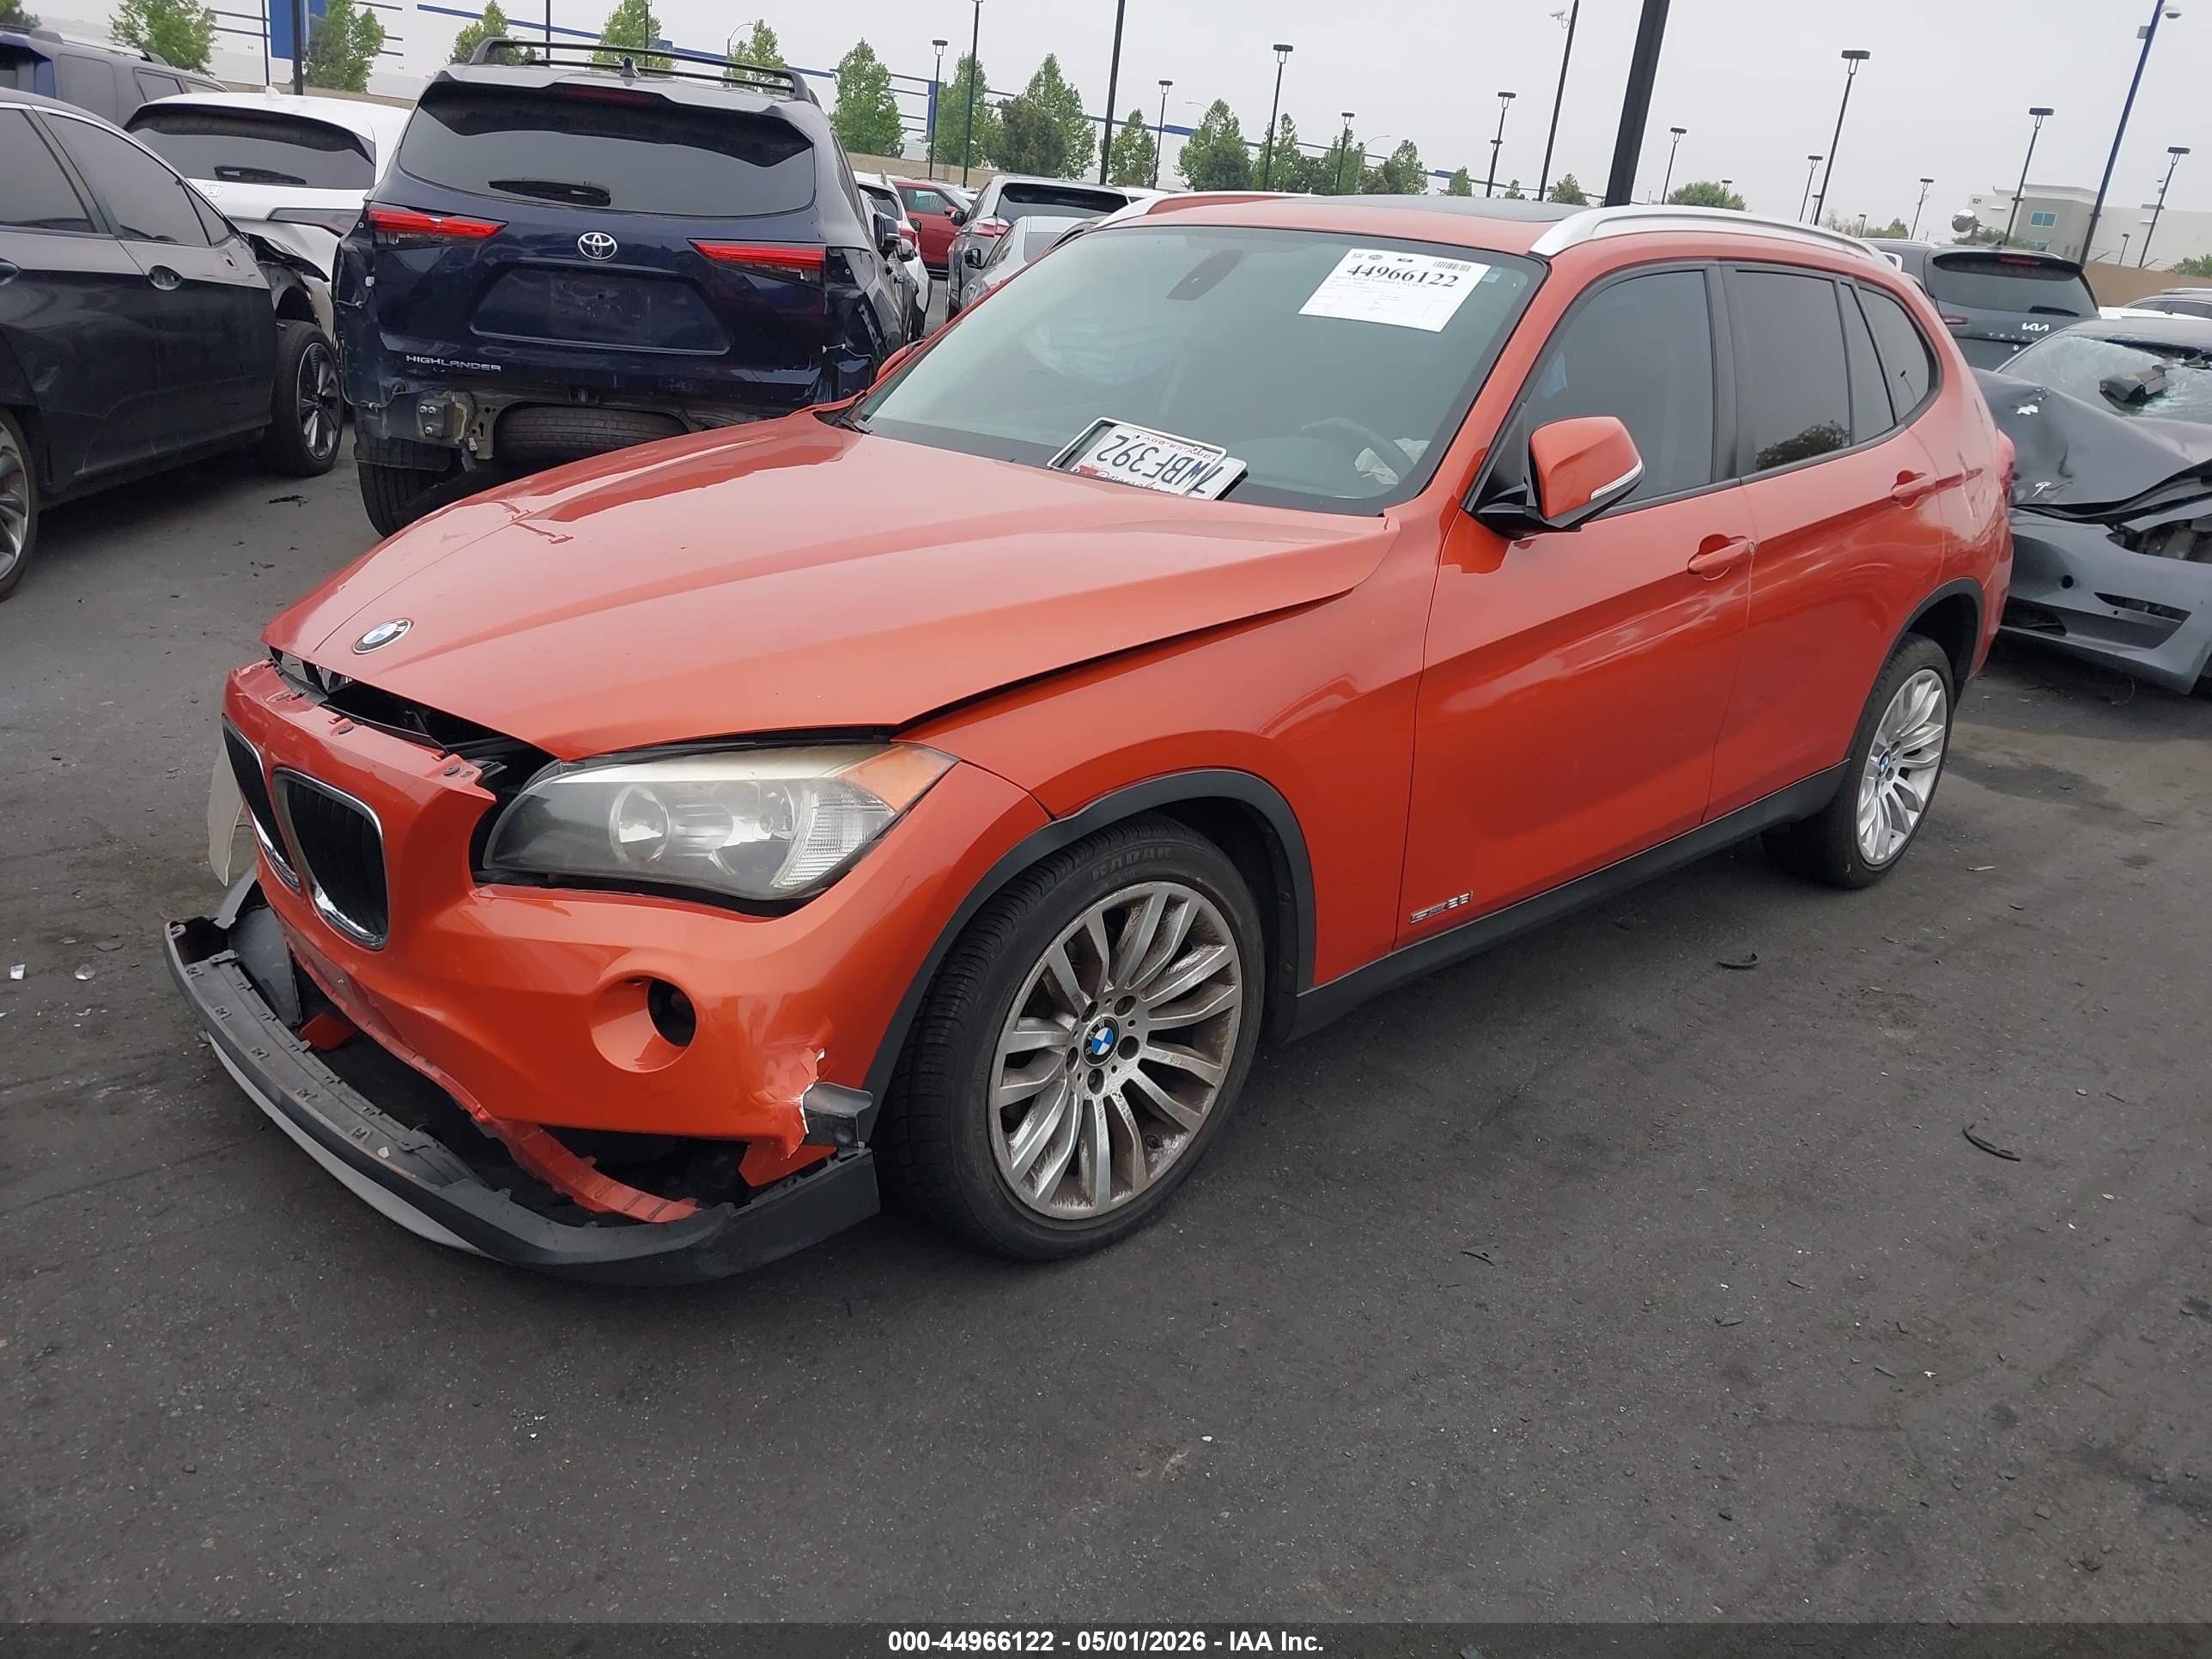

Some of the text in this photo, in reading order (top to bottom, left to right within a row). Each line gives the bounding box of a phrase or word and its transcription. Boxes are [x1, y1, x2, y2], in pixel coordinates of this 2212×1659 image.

[1347, 264, 1459, 287] 44966122
[1987, 332, 2038, 341] TELLU
[405, 355, 501, 372] HIGHLANDER
[1097, 434, 1224, 495] 7WBF392
